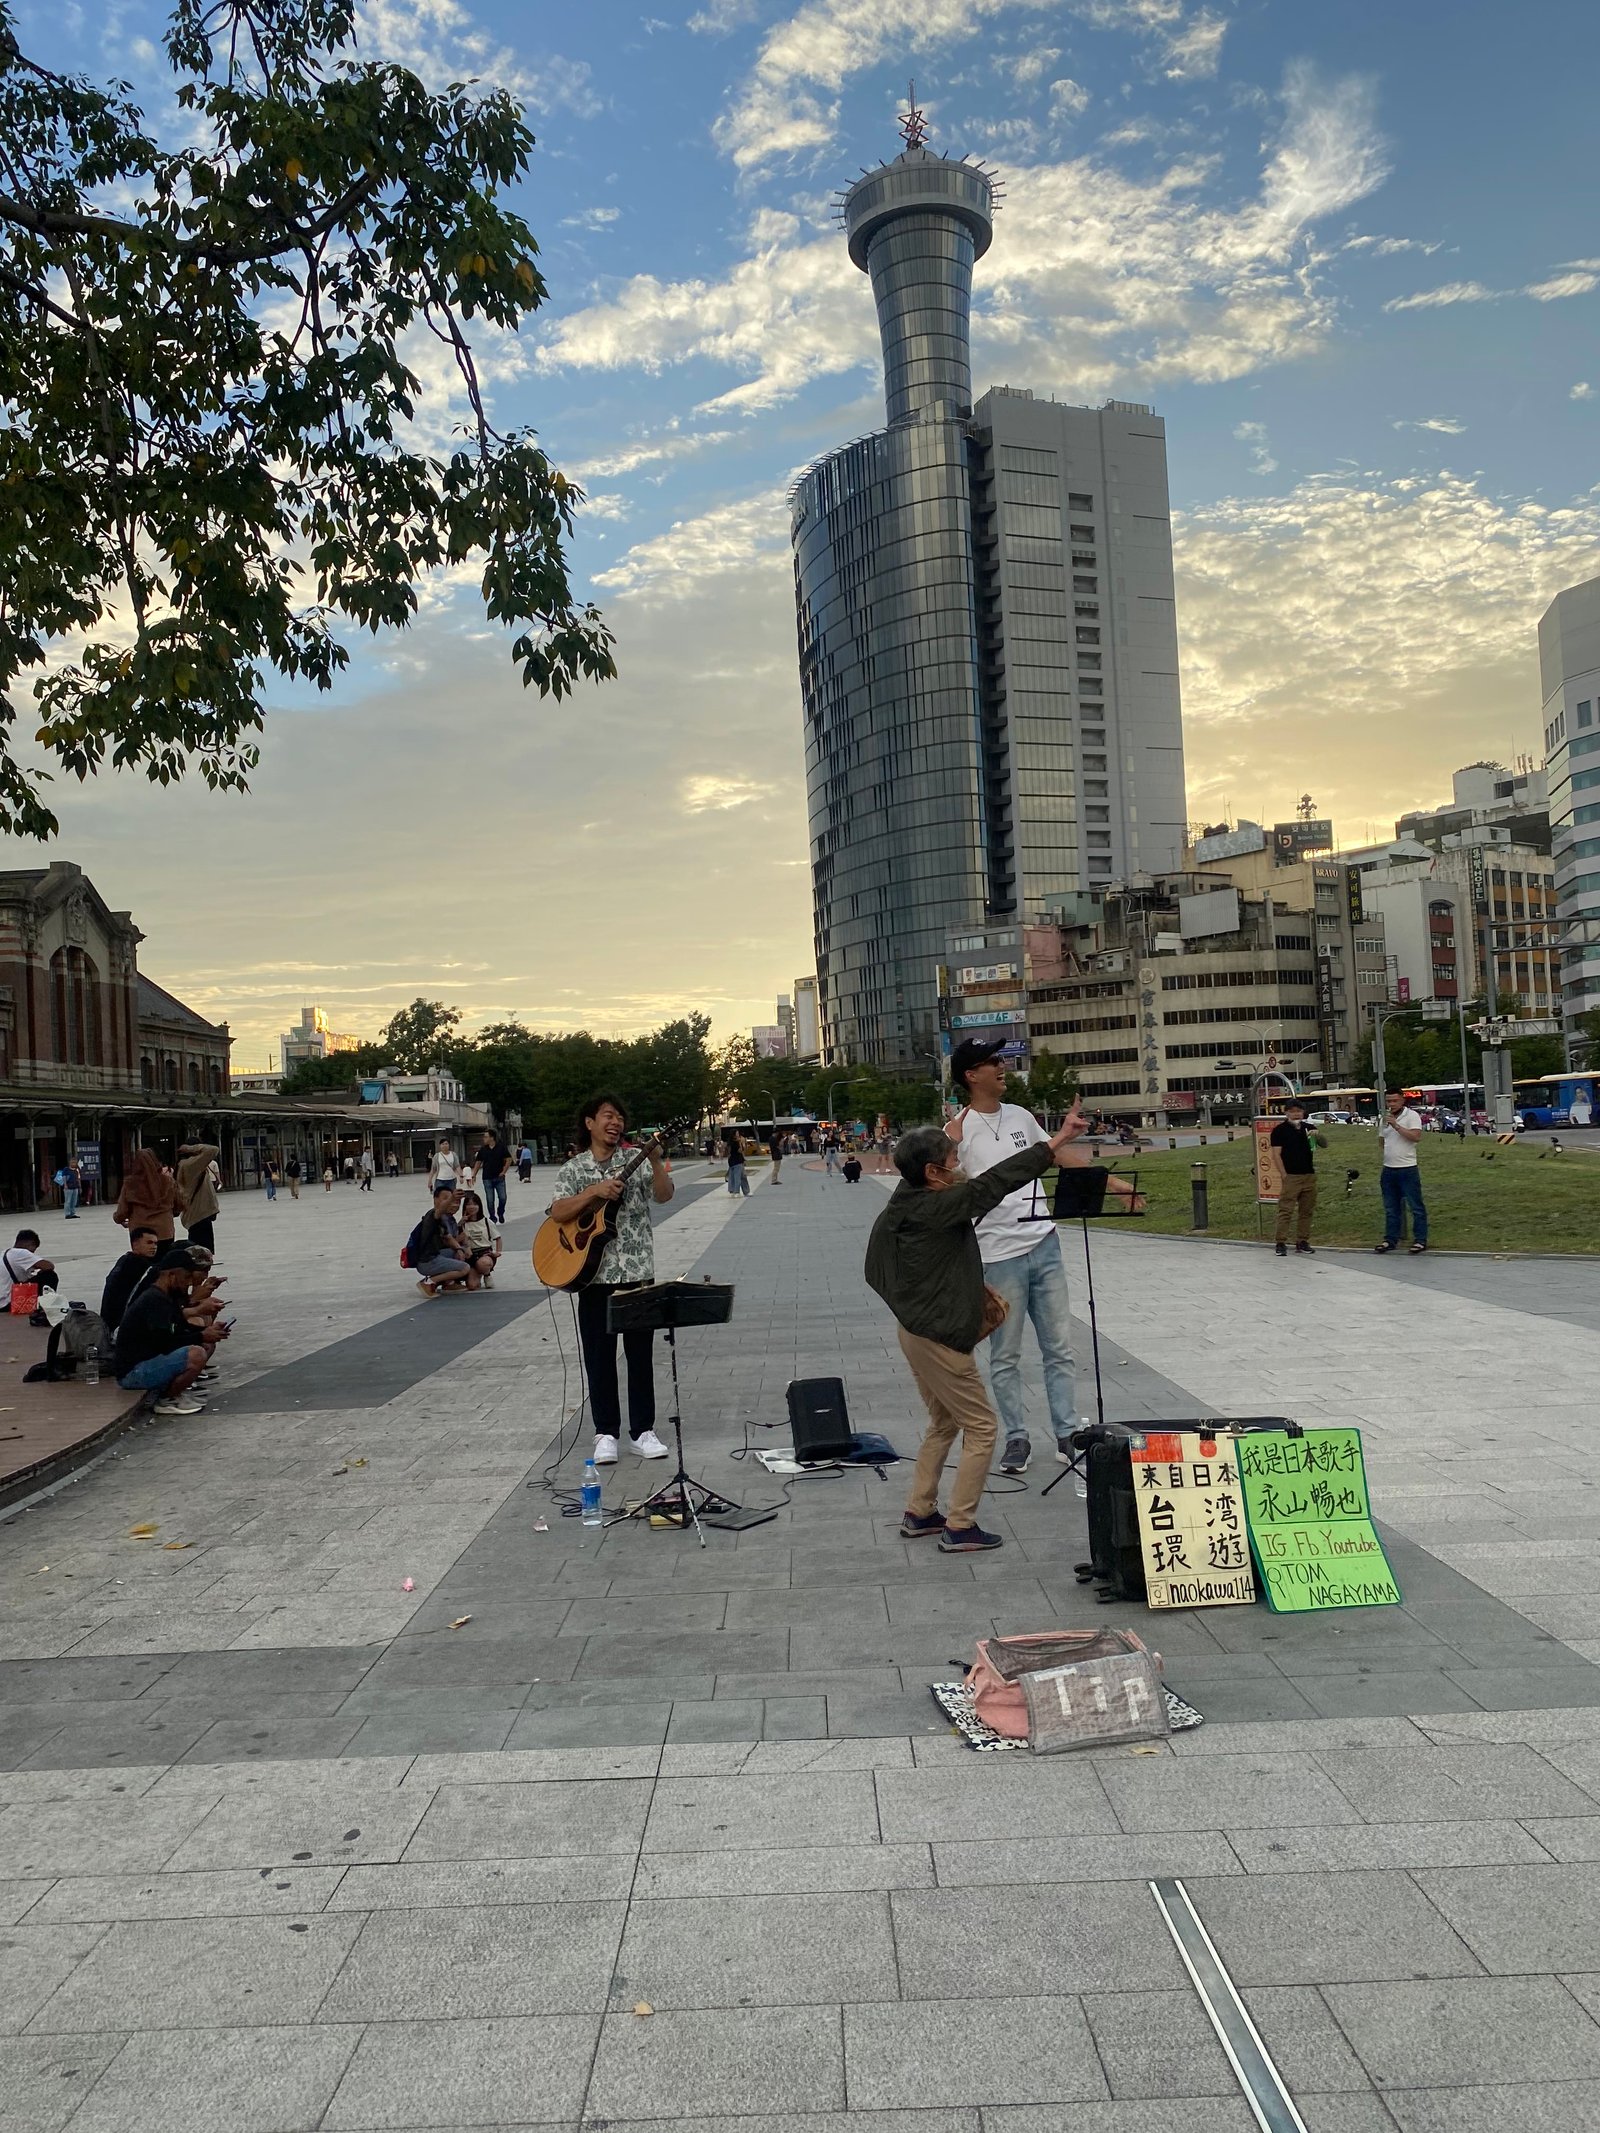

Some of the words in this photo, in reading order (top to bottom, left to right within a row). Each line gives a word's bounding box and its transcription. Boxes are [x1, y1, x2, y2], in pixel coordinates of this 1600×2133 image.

[1315, 868, 1338, 878] BRAVO
[1349, 869, 1361, 921] 安可旅店
[1242, 1439, 1360, 1477] 我是日本歌手
[1281, 1563, 1330, 1585] TOM
[1169, 1575, 1255, 1604] naokawa114
[1309, 1582, 1400, 1607] NAGAYAMA
